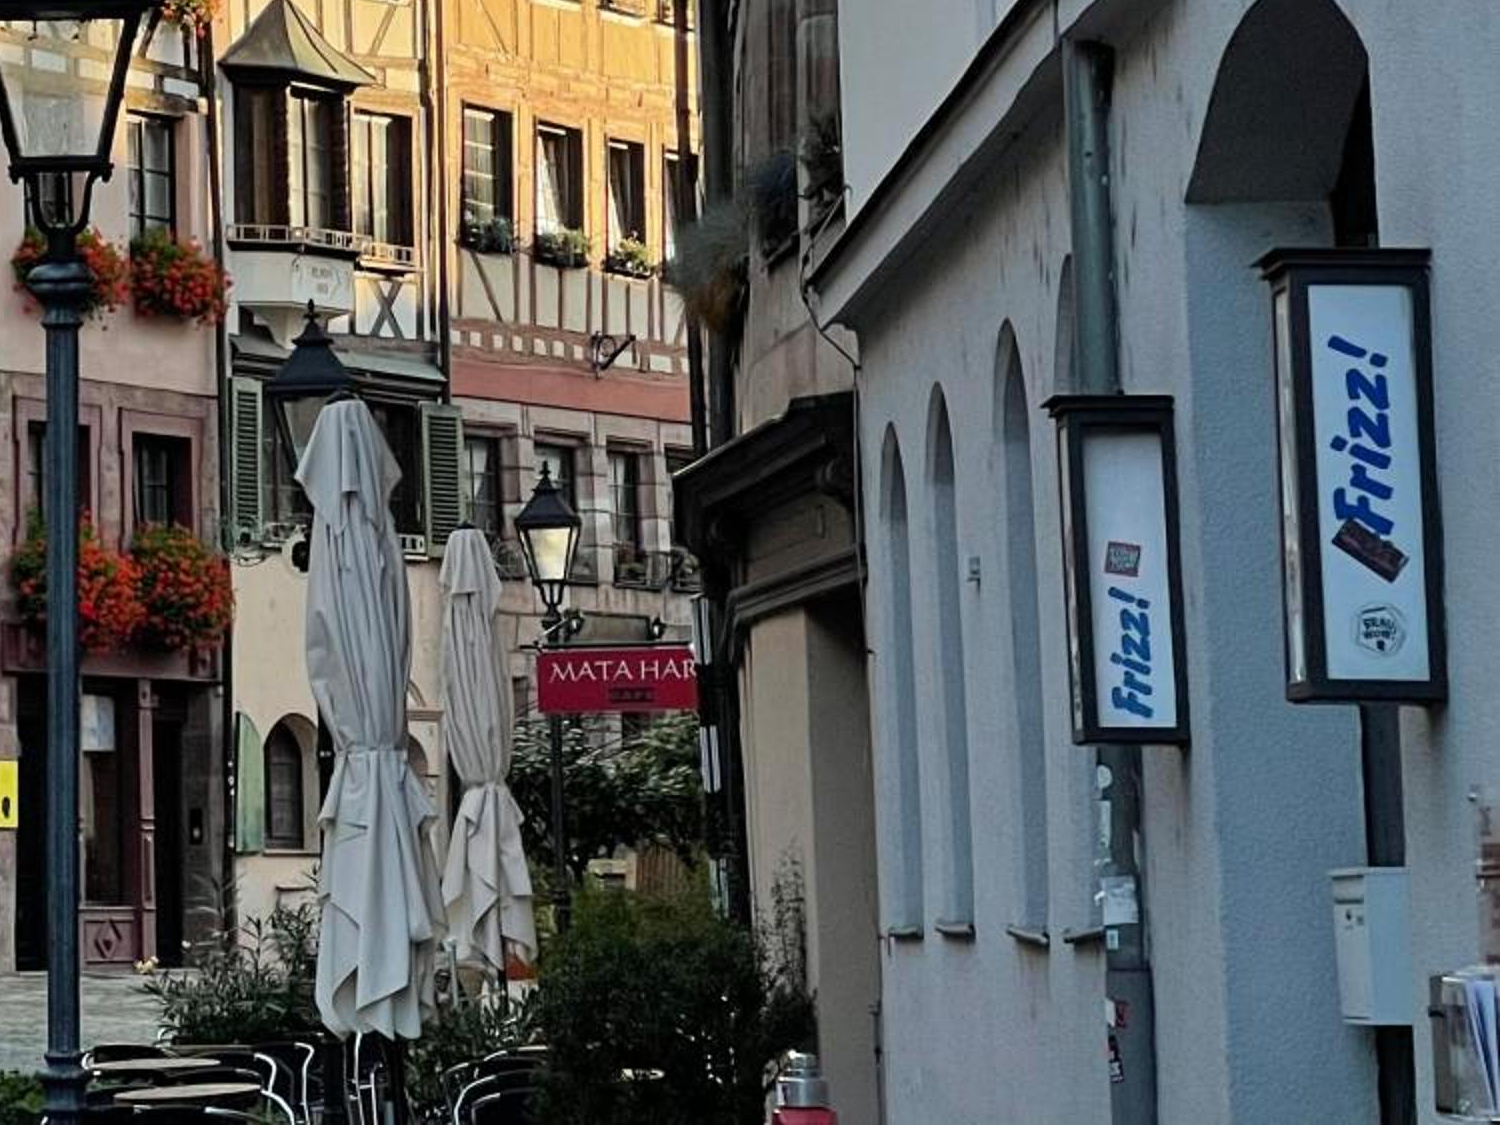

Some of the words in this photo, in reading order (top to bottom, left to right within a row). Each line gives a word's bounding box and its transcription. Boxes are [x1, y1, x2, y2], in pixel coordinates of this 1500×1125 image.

[1327, 334, 1395, 536] Frizz!
[550, 659, 633, 682] MATA
[641, 658, 697, 680] HAR
[1108, 586, 1153, 718] Frizz!
